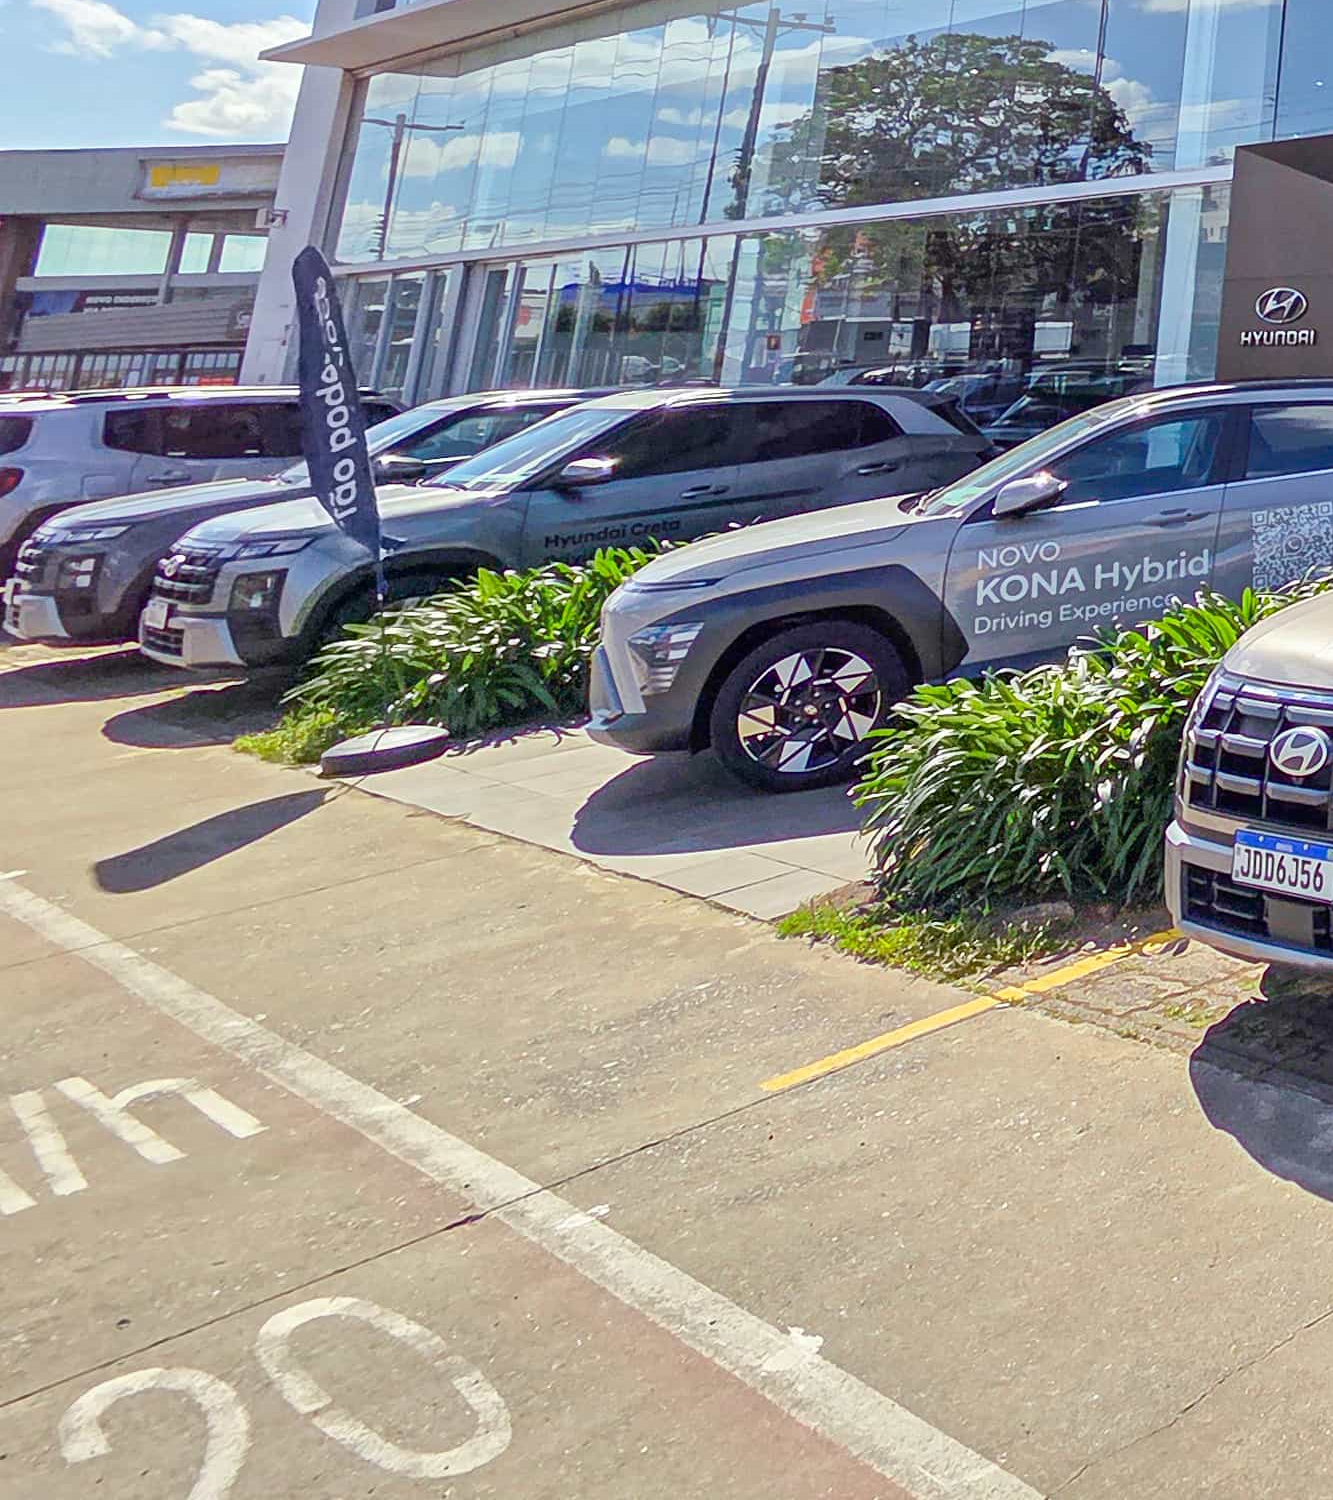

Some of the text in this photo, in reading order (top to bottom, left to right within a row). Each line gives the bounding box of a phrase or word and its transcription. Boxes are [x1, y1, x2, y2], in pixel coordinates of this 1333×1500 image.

[1240, 329, 1316, 346] HYUNDAI
[544, 518, 682, 550] Hyundai Creta
[977, 541, 1061, 571] NOVO
[975, 548, 1210, 607] KONA Hybrid
[973, 608, 1053, 636] Driving
[1240, 848, 1324, 893] JDD6J56
